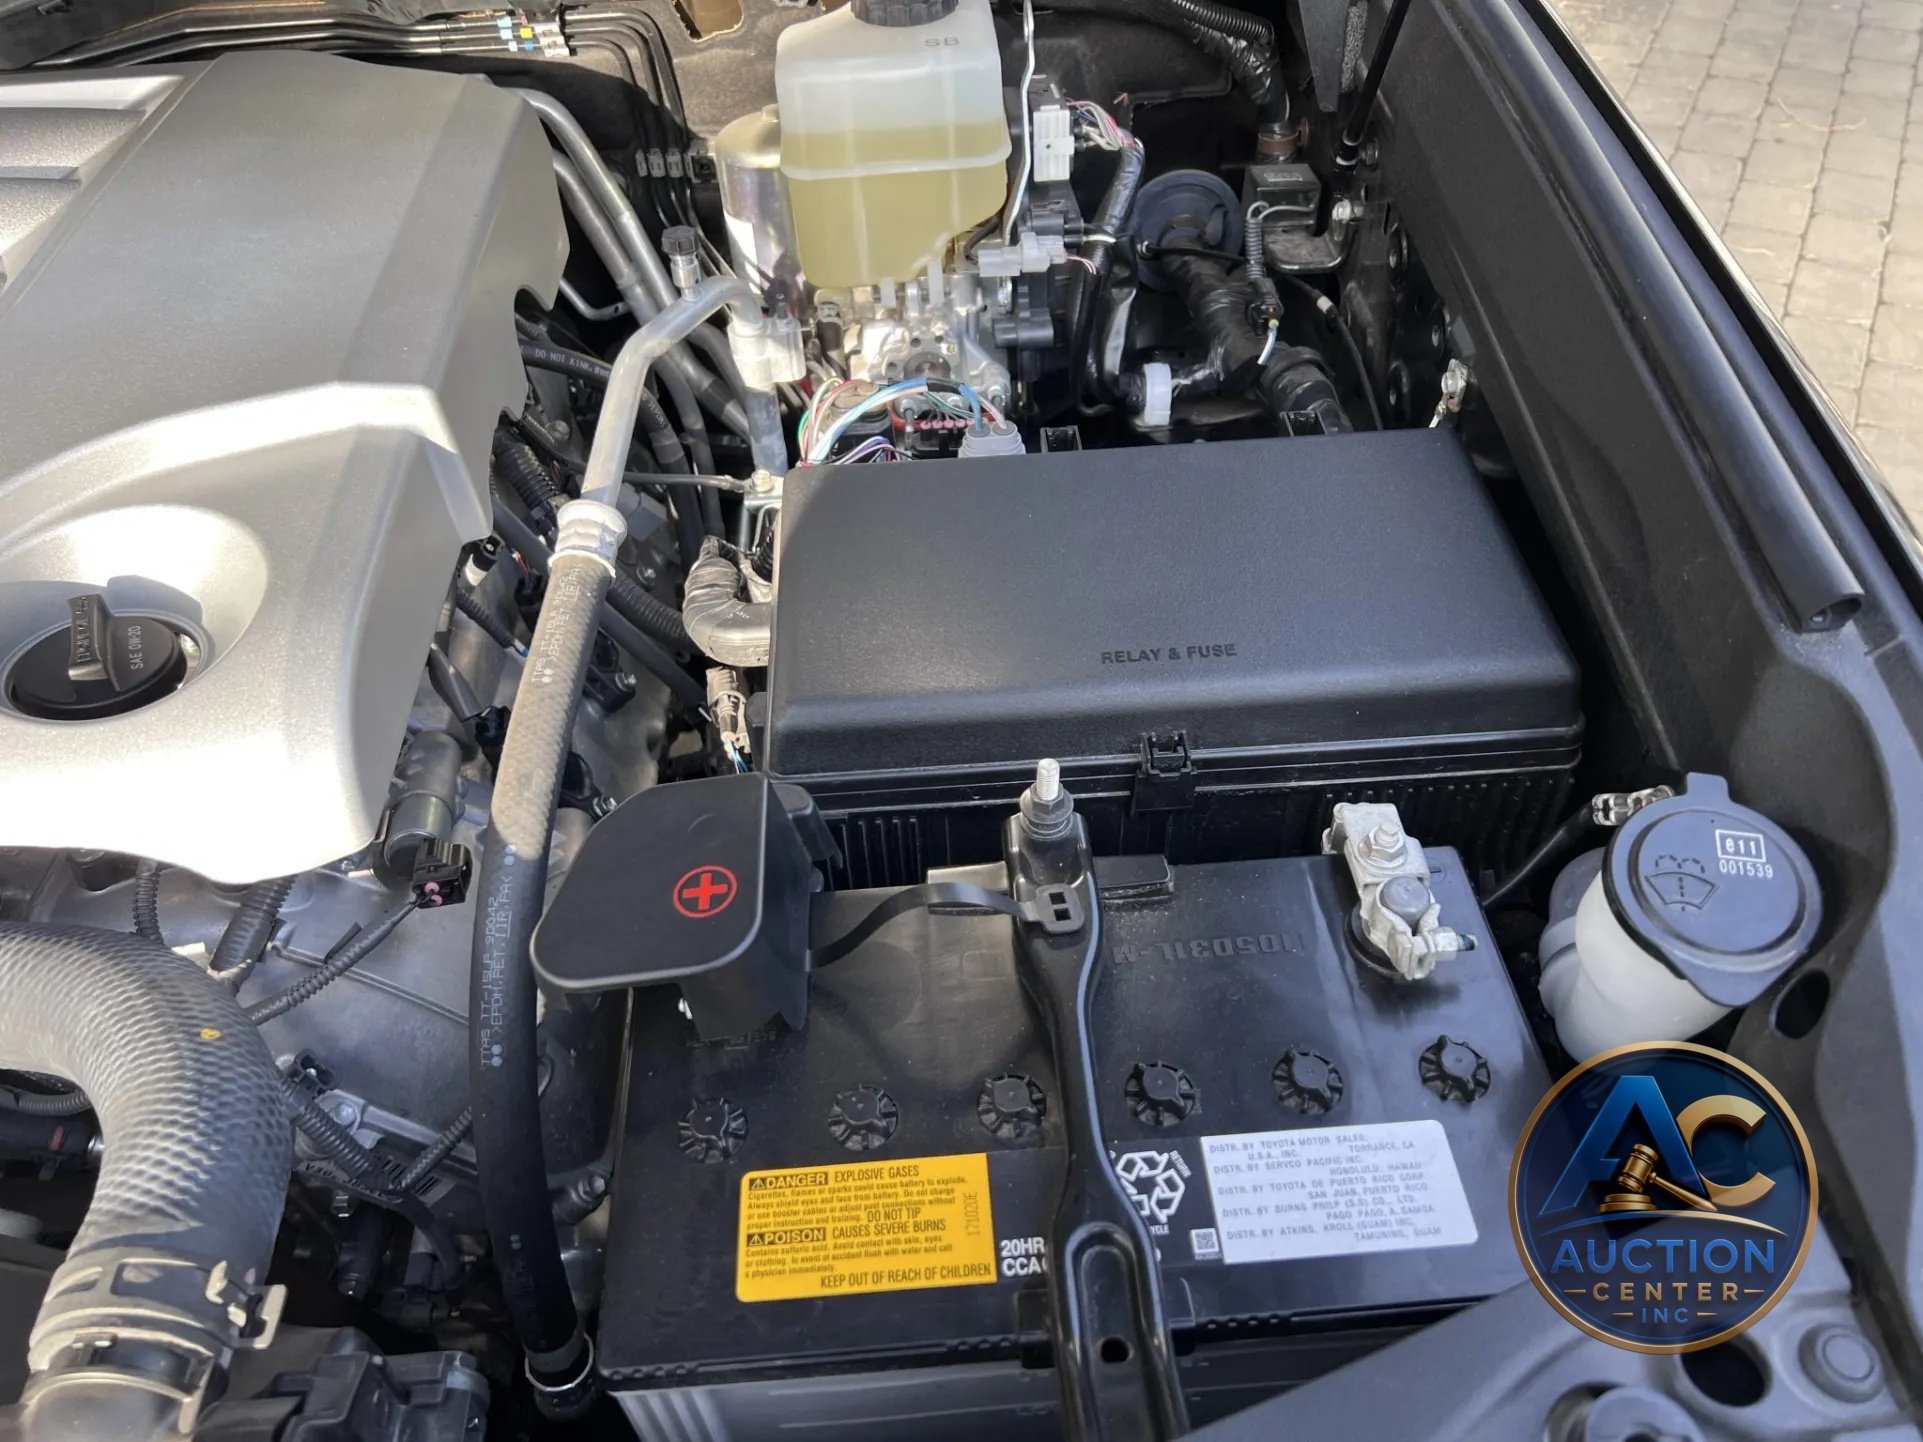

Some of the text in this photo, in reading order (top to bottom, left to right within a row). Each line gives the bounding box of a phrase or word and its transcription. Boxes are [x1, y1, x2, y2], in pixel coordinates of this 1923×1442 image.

[924, 37, 959, 46] SB
[535, 348, 546, 359] DO
[551, 353, 565, 362] NOT
[128, 626, 144, 669] SAE 0W-20
[1101, 644, 1236, 664] RELAY & FUSE
[1726, 837, 1756, 855] e11
[1719, 860, 1773, 878] 001539
[1210, 1144, 1240, 1153] DISTR.
[1243, 1143, 1254, 1151] BY
[1260, 1140, 1295, 1149] TOYOTA
[1298, 1137, 1331, 1145] MOTOR
[1402, 1141, 1415, 1149] CA
[1170, 1150, 1191, 1177] RETURN
[1266, 1161, 1301, 1170] SERVCO
[1307, 1157, 1343, 1167] PACIFIC
[767, 1165, 919, 1188] DANGER EXPLOSIVE GASES
[829, 1186, 851, 1194] sparks
[900, 1180, 924, 1188] battery
[937, 1176, 967, 1185] explode.
[1252, 1185, 1263, 1193] BY
[1270, 1181, 1306, 1191] TOYOTA
[1312, 1179, 1323, 1188] DE
[1330, 1176, 1367, 1186] PUERTO
[1372, 1174, 1394, 1182] RICO
[1308, 1191, 1327, 1199] SAN
[1363, 1185, 1400, 1195] PUERTO
[1405, 1183, 1428, 1191] RICO
[748, 1201, 773, 1209] Always
[773, 1208, 800, 1217] booster
[803, 1206, 827, 1215] cables
[839, 1203, 861, 1212] adjust
[929, 1196, 955, 1204] without
[1257, 1206, 1268, 1214] BY
[1275, 1203, 1307, 1213] BURNS
[1327, 1210, 1352, 1220] PAGO
[1401, 1205, 1434, 1214] SAMOA
[747, 1222, 771, 1230] proper
[773, 1218, 813, 1227] instruction
[868, 1210, 880, 1222] DO
[884, 1208, 902, 1220] NOT
[907, 1207, 920, 1219] TIP
[765, 1218, 945, 1244] POISON CAUSES SEVERE BURNS
[1150, 1224, 1169, 1235] YCLE
[1262, 1229, 1273, 1237] BY
[1323, 1222, 1354, 1232] KROLL
[1357, 1219, 1392, 1229] (GUAM)
[1413, 1226, 1441, 1236] GUAM
[746, 1249, 778, 1257] Contains
[833, 1242, 853, 1250] Avoid
[856, 1238, 883, 1248] contact
[886, 1237, 902, 1245] with
[925, 1236, 942, 1244] eyes
[832, 1251, 862, 1260] accident
[884, 1247, 899, 1255] with
[902, 1246, 921, 1254] water
[939, 1243, 952, 1251] call
[752, 1267, 786, 1279] physician
[821, 1263, 991, 1288] KEEP OUT OF REACH OF CHILDREN
